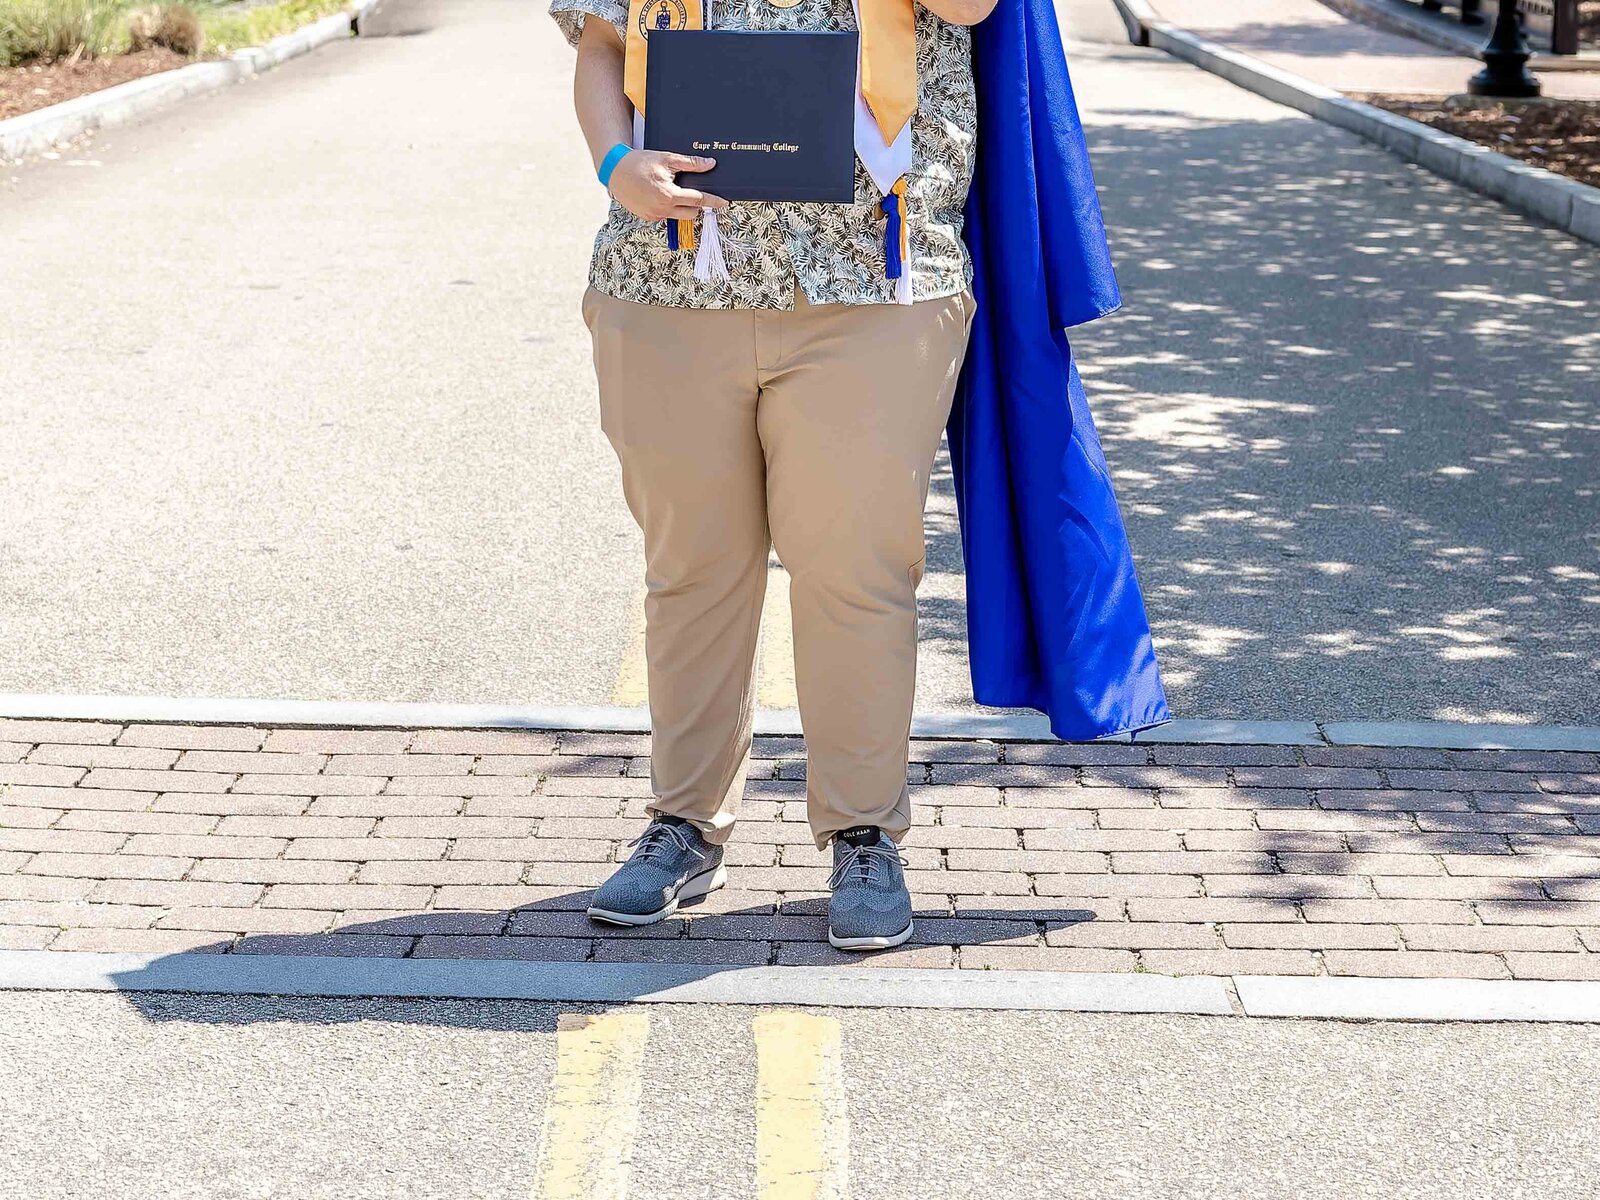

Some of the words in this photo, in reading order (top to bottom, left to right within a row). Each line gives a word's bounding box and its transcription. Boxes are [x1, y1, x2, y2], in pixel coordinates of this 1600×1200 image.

[692, 141, 710, 151] Cape
[712, 141, 729, 150] Fear
[730, 142, 770, 153] Community
[772, 142, 799, 153] College
